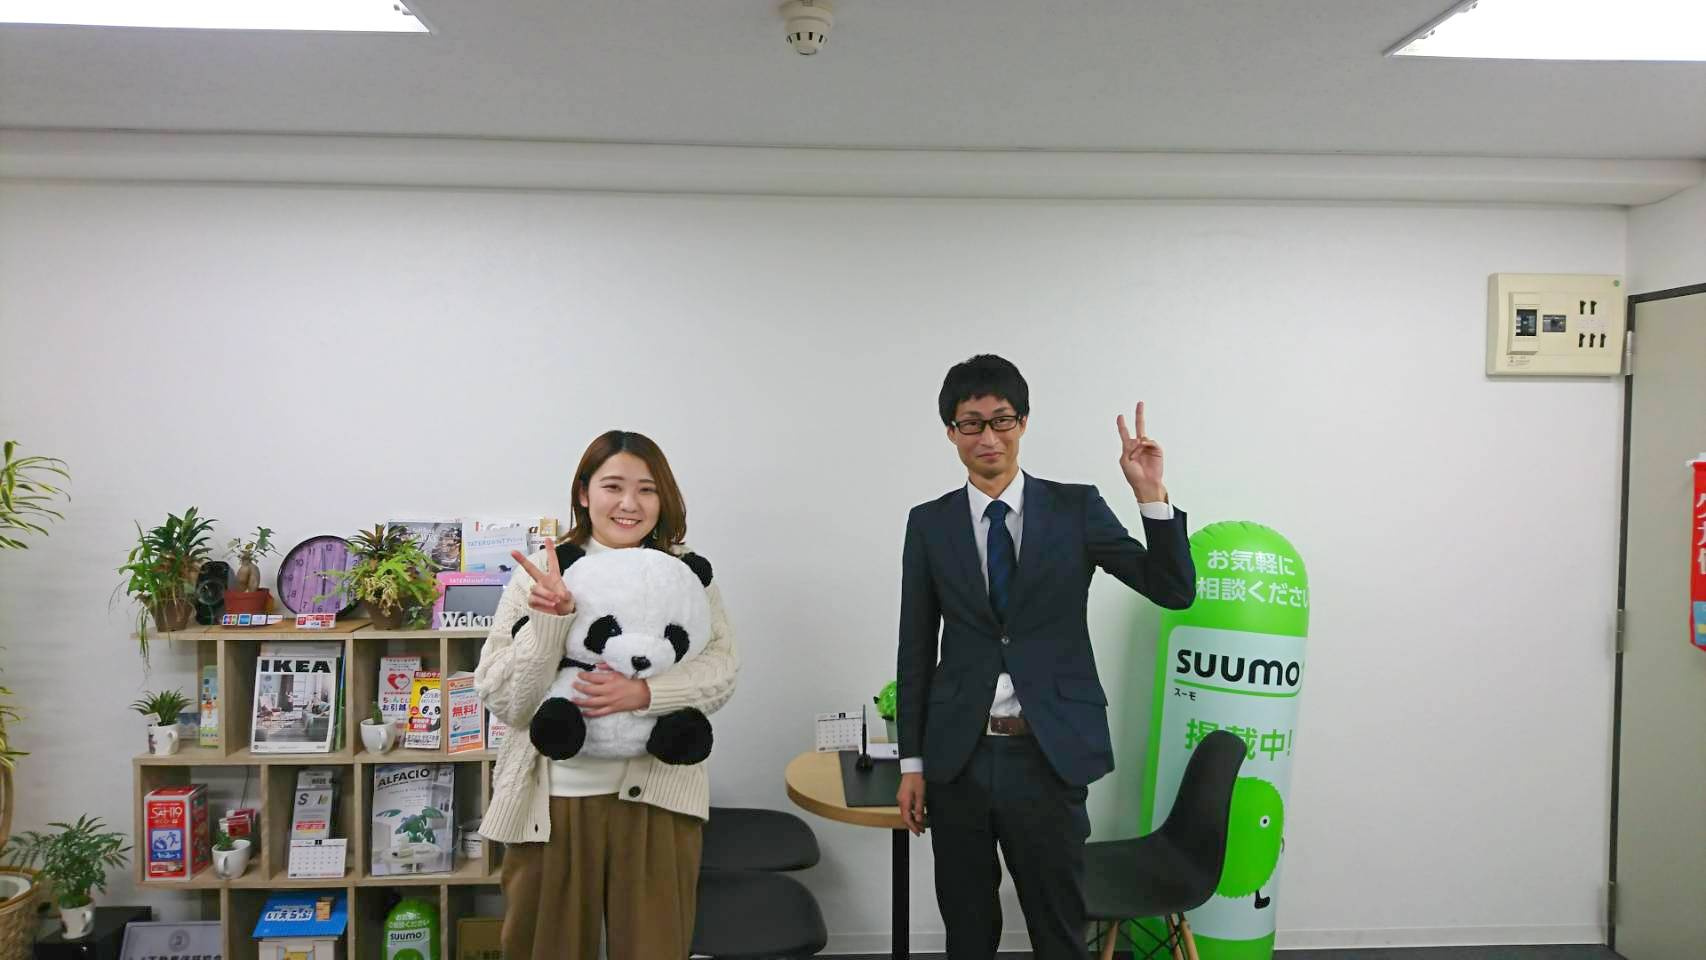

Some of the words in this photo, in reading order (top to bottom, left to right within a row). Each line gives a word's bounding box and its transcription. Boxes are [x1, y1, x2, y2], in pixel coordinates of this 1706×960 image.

[1208, 549, 1295, 576] お気軽に
[261, 659, 332, 674] IKEA
[1174, 687, 1196, 701] スーモ
[376, 768, 431, 787] ALFACIO
